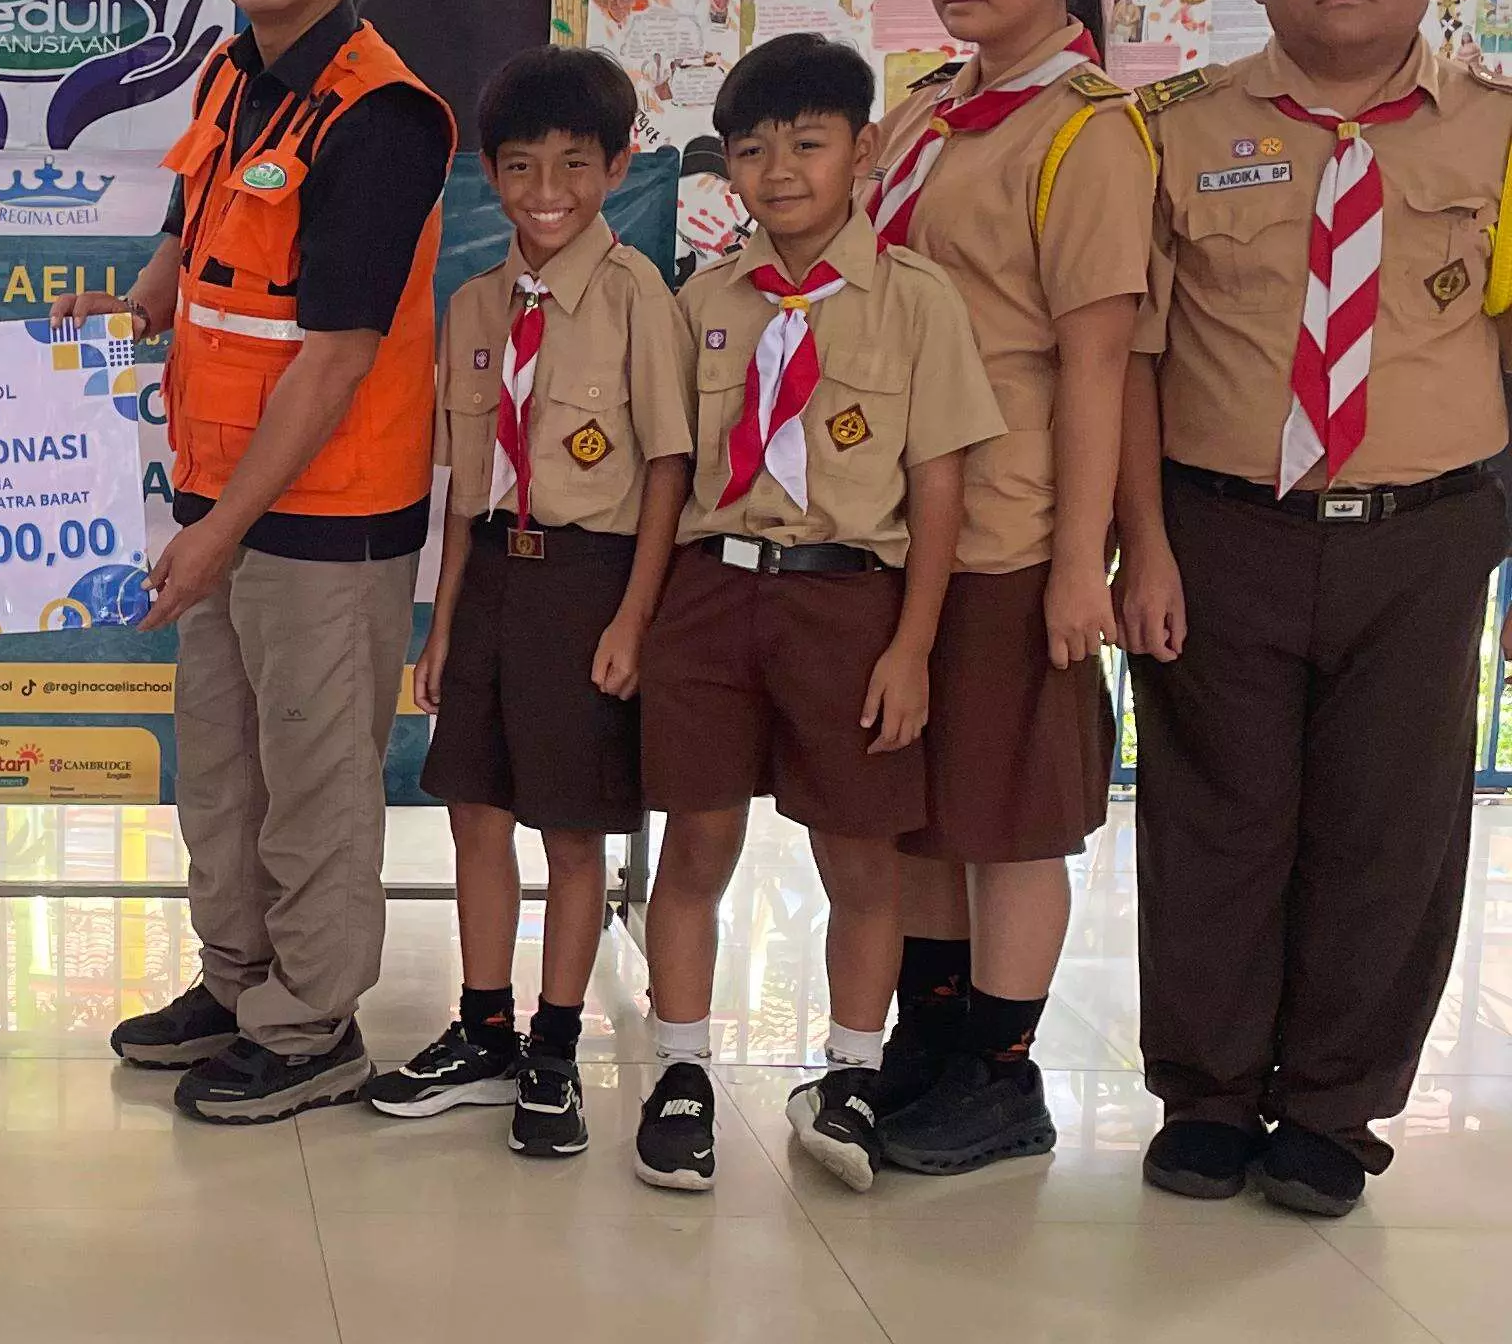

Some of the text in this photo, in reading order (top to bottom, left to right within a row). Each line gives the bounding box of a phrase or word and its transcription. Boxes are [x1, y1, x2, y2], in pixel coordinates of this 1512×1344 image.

[1219, 169, 1261, 187] ANDIKA
[55, 207, 101, 226] CAELI
[39, 490, 91, 507] BARAT
[43, 680, 173, 695] @reginacaelischool
[0, 737, 10, 748] by
[63, 760, 132, 772] CAMBRIDGE
[659, 1098, 704, 1118] NIKE
